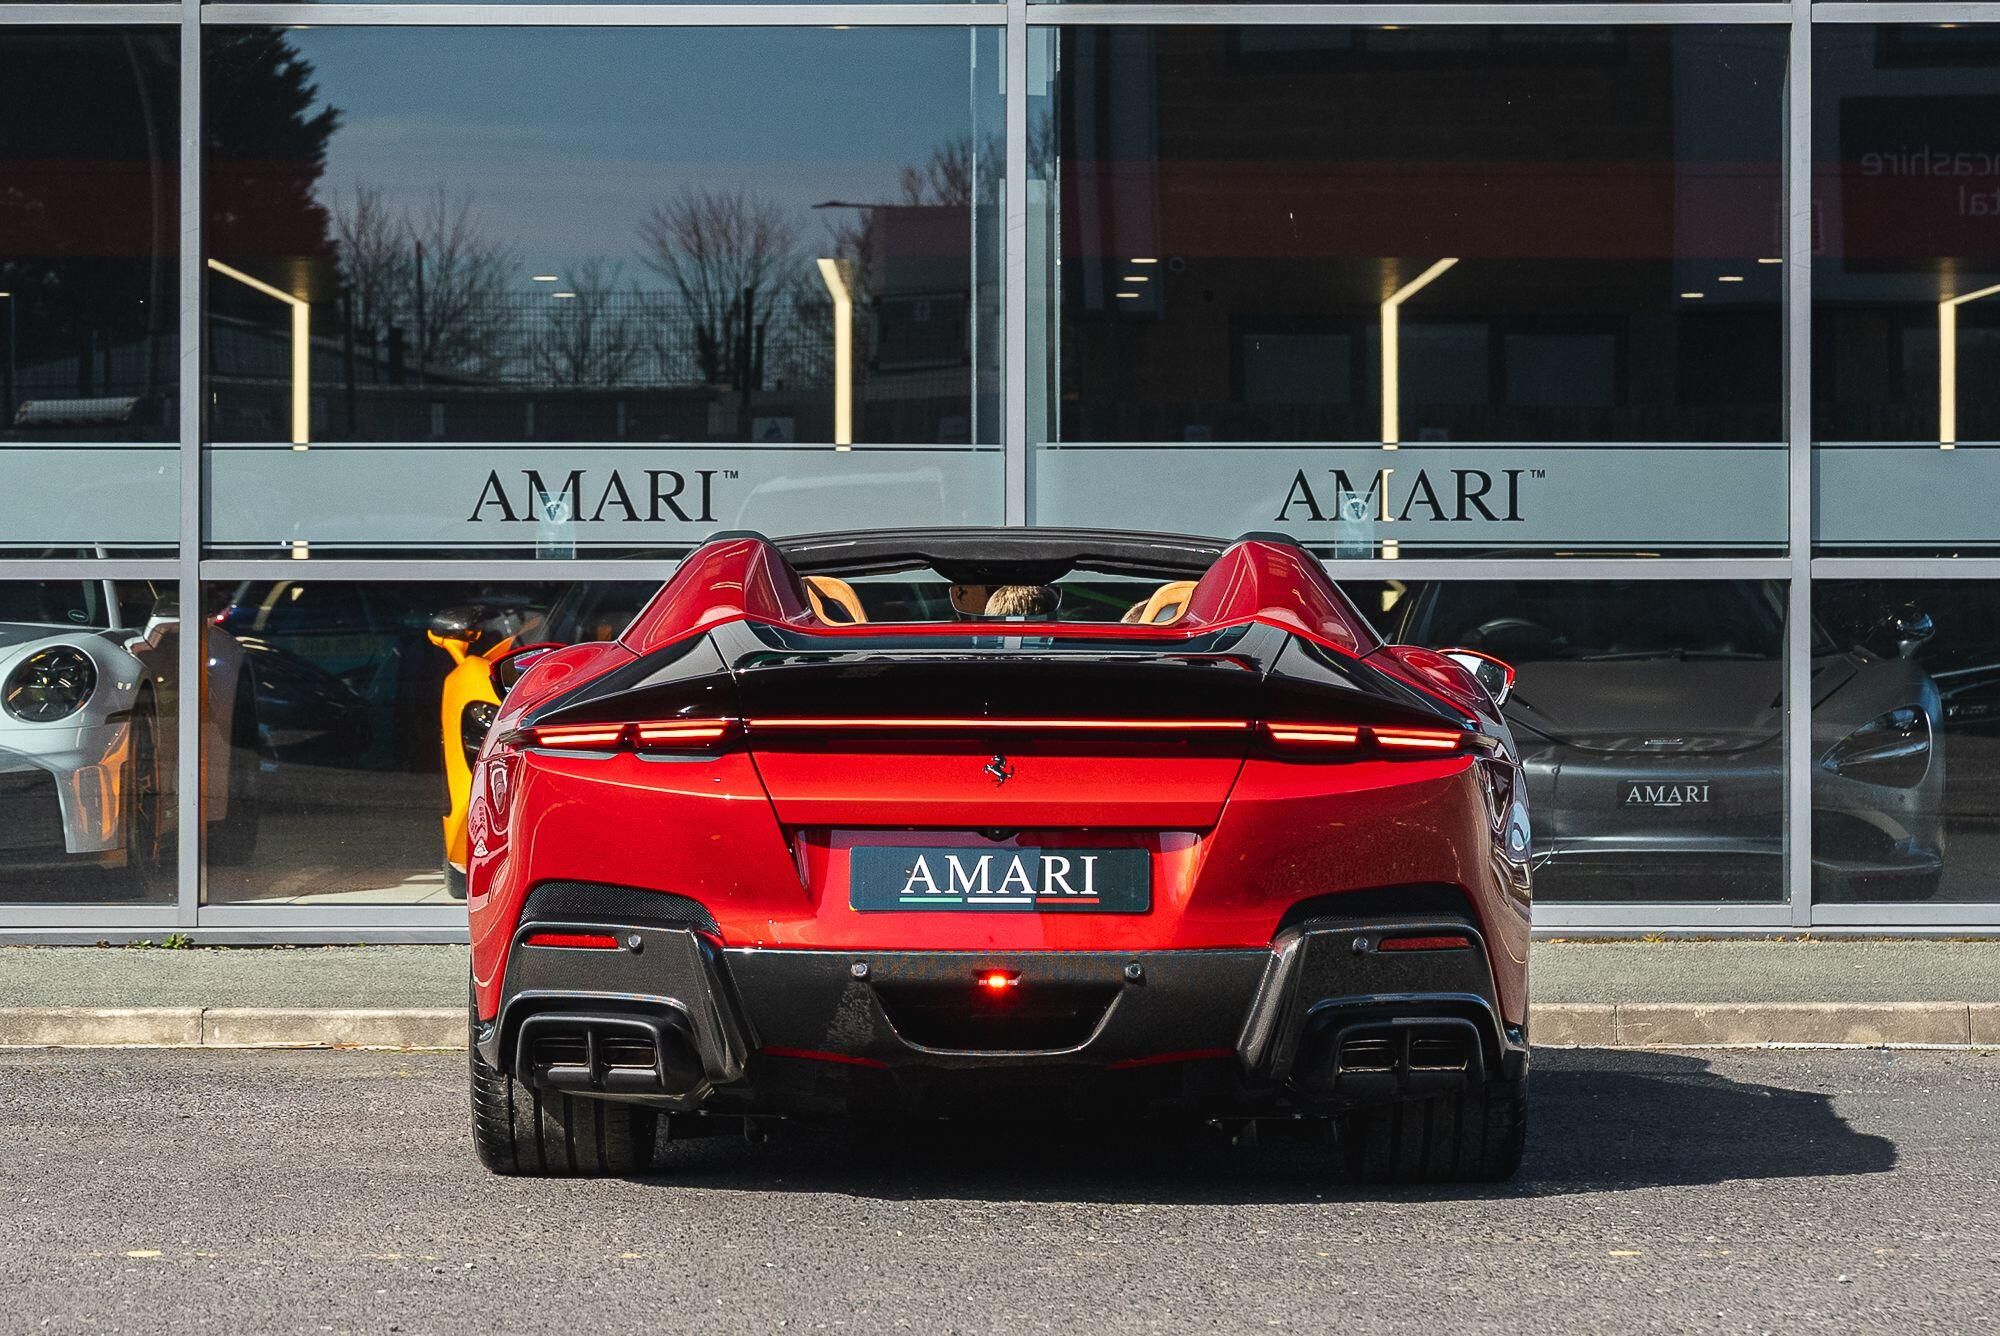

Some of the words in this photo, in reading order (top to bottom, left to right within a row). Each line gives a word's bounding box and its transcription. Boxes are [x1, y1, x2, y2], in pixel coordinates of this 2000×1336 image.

[467, 469, 718, 522] AMARI
[1274, 468, 1525, 522] AMARI
[1626, 785, 1710, 803] AMARI
[900, 854, 1099, 895] AMARI
